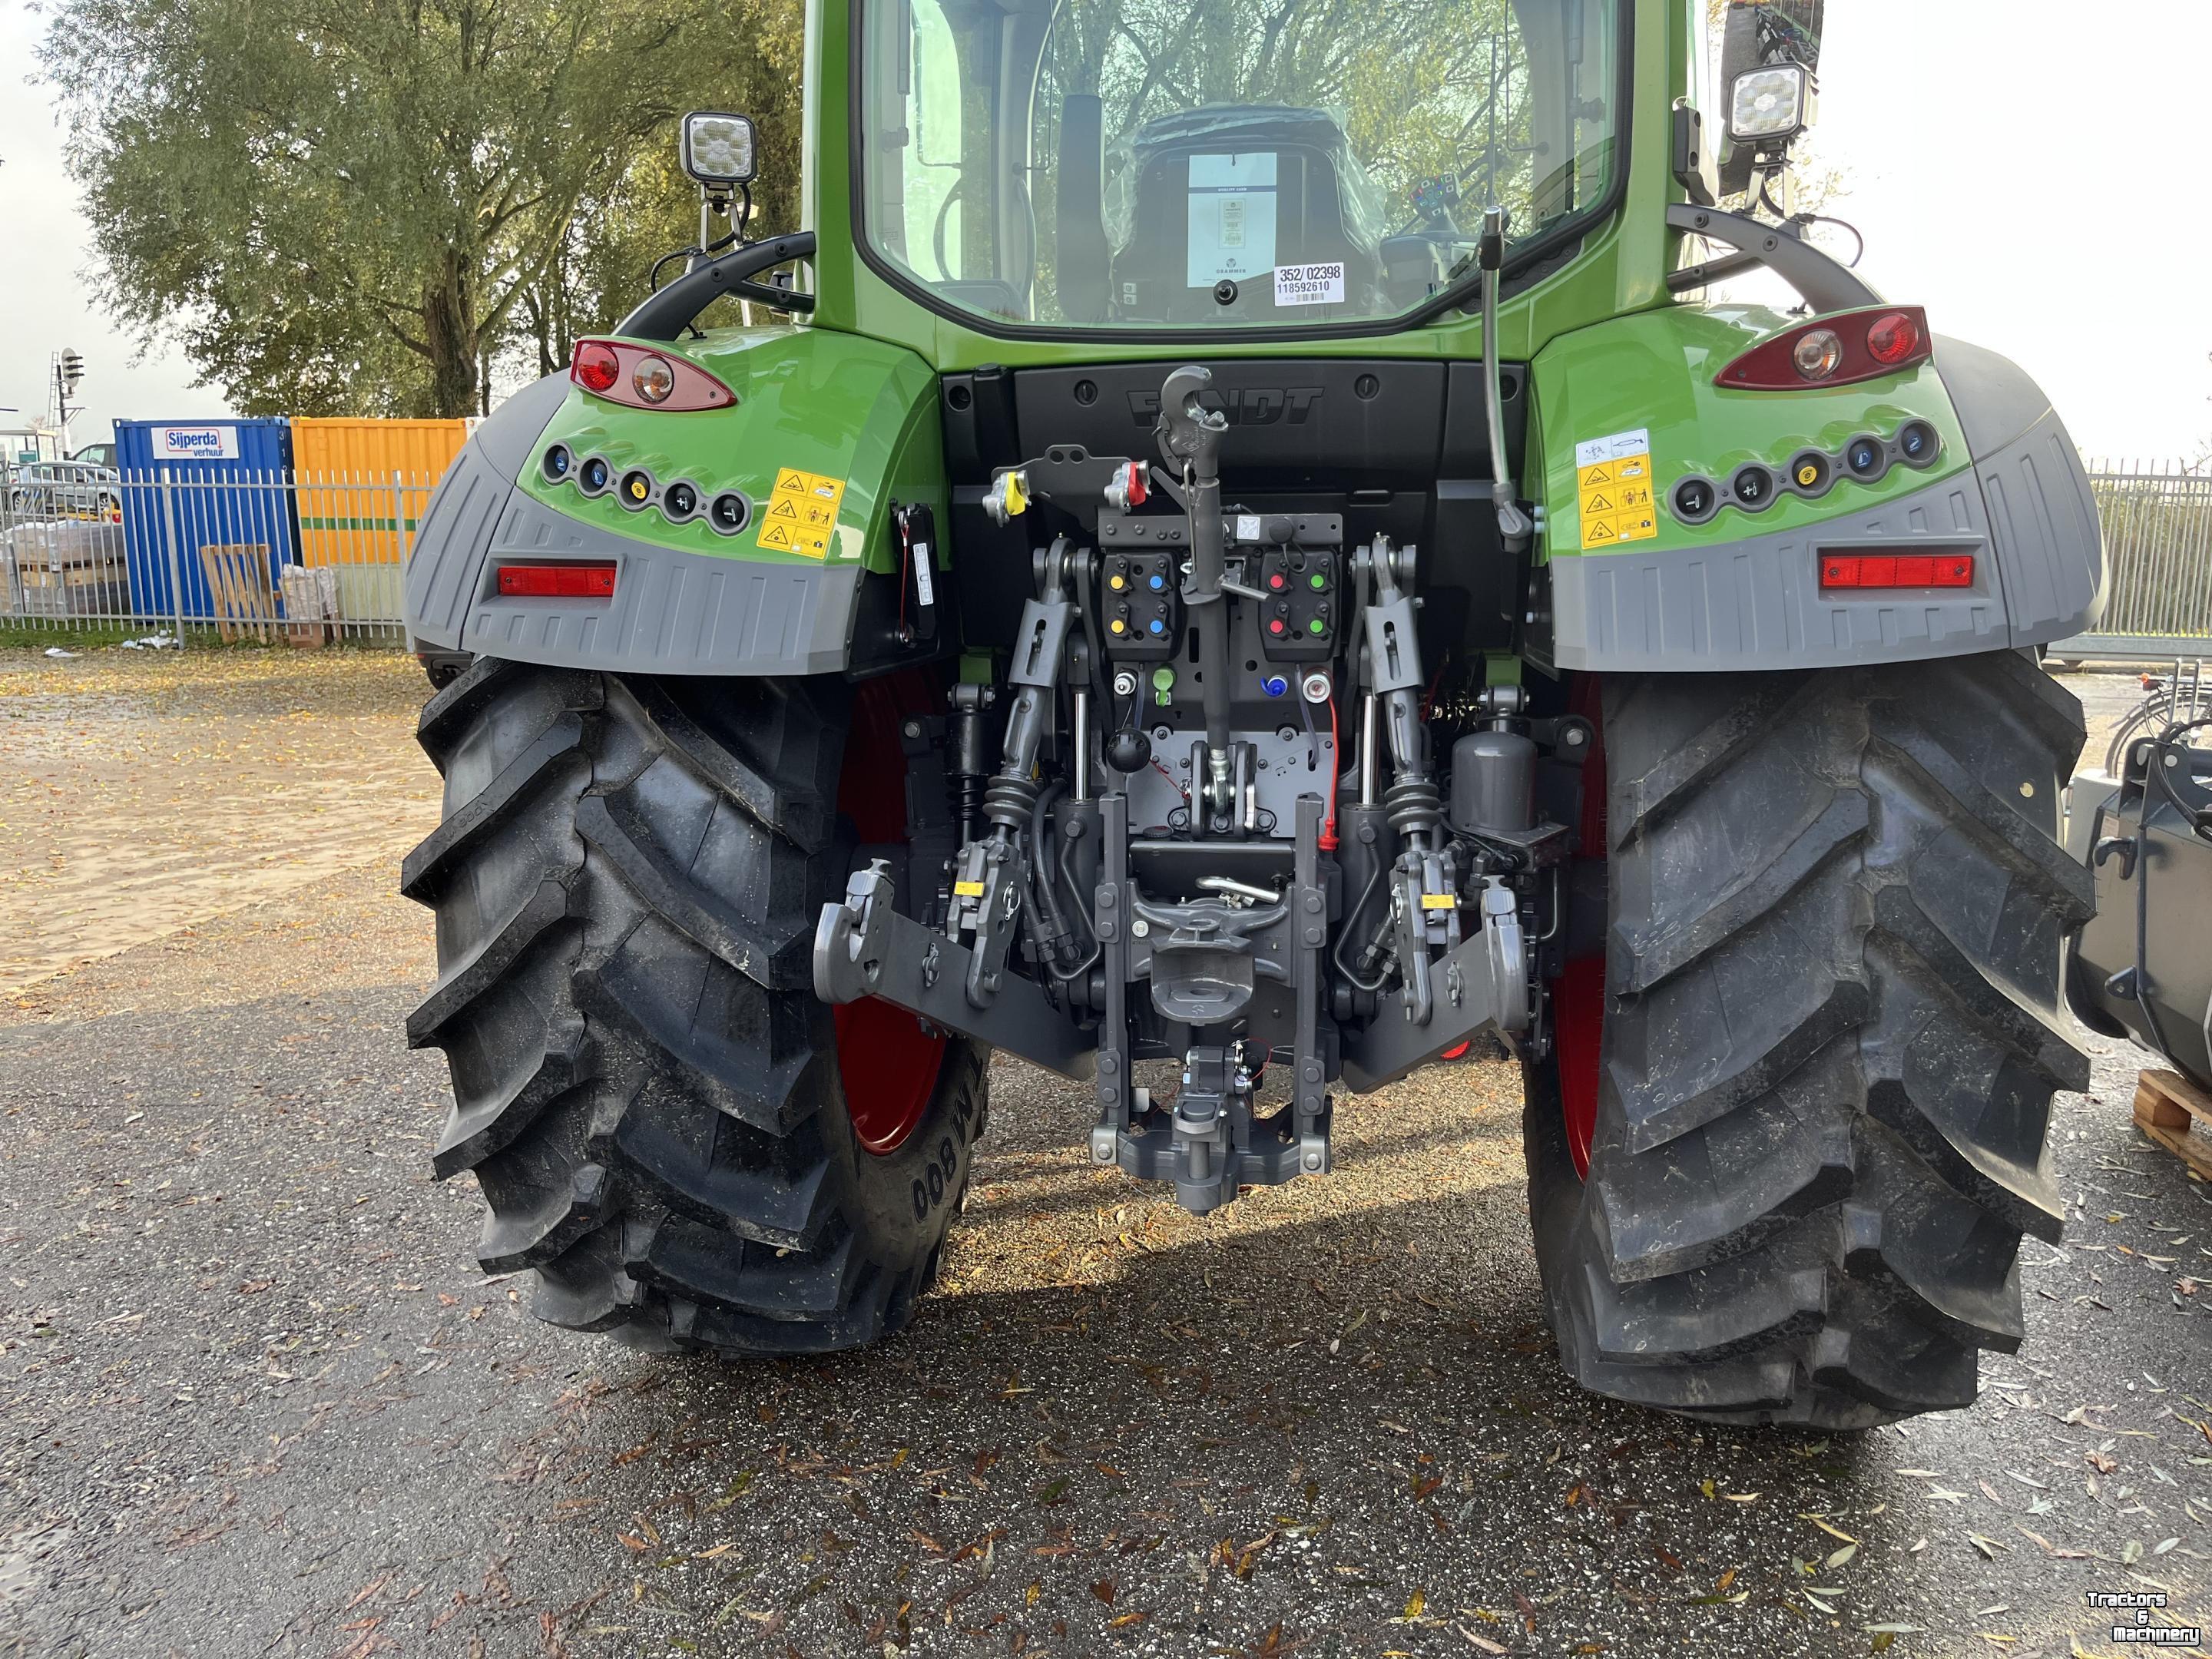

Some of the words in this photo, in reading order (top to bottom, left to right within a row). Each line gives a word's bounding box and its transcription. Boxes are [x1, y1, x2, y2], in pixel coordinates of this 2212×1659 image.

[1277, 280, 1330, 294] 118592610
[1127, 387, 1325, 428] FNDT
[168, 432, 217, 449] Sijperda
[193, 448, 224, 457] verhuur
